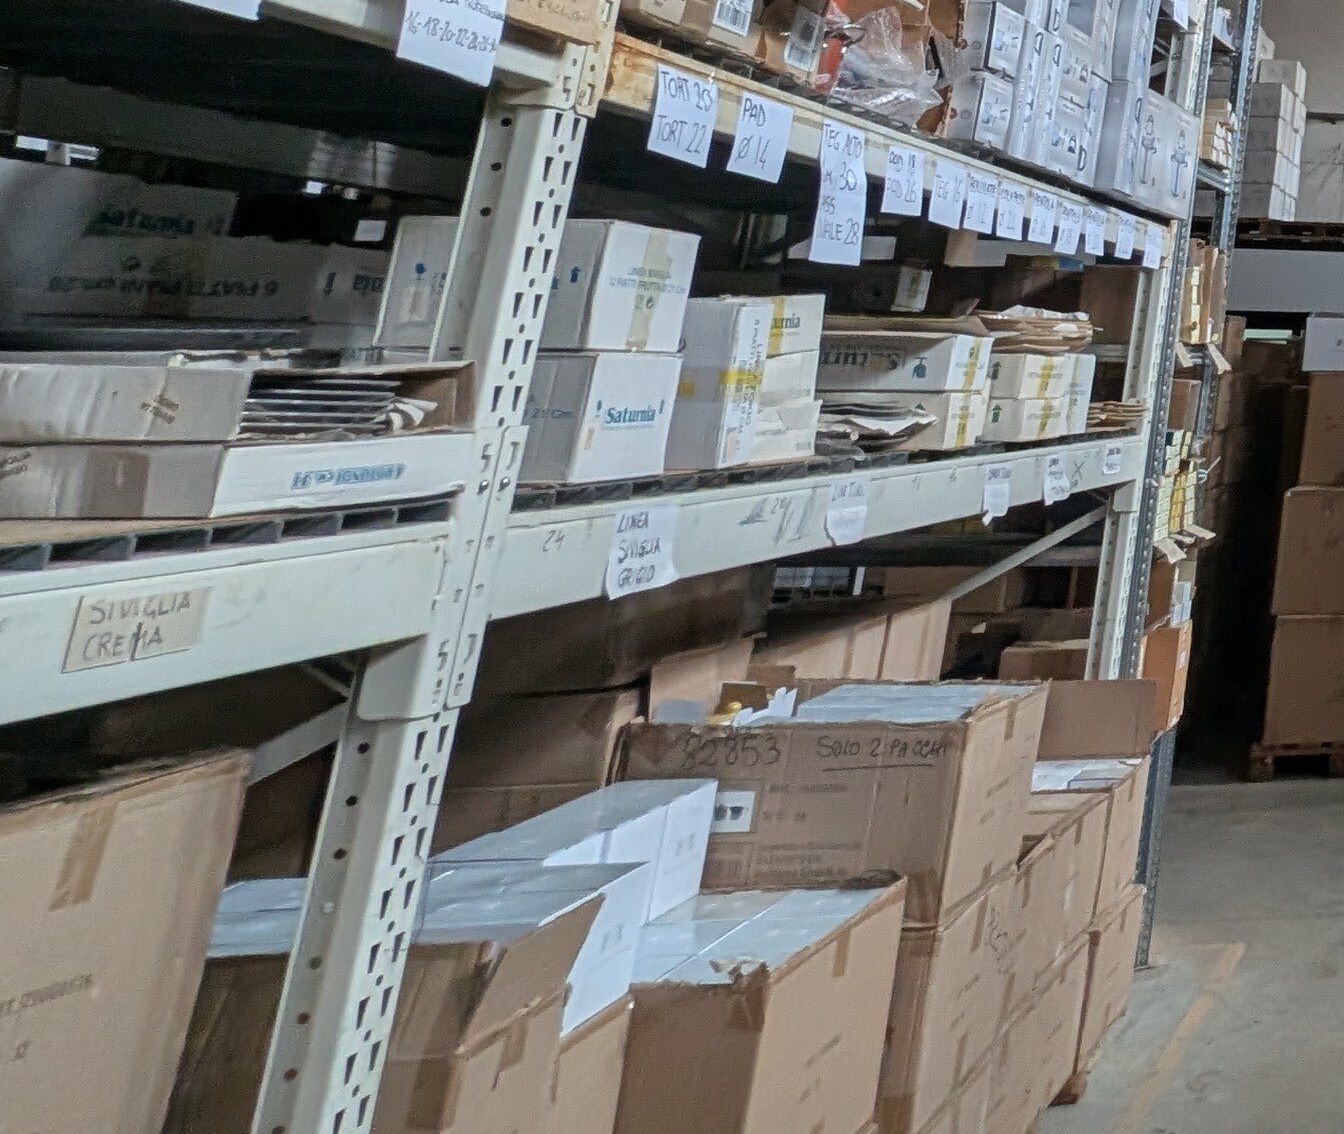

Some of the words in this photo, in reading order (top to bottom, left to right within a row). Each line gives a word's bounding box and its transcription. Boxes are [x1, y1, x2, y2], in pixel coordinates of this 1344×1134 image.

[660, 70, 691, 102] TORT
[743, 97, 766, 127] PAD
[656, 115, 688, 148] TORT
[686, 121, 707, 155] 22
[824, 123, 840, 151] TEG
[754, 136, 770, 171] 14
[838, 161, 858, 192] 30
[843, 217, 859, 247] 28
[605, 406, 656, 424] Saturnia
[617, 510, 650, 534] LINEA
[89, 593, 191, 625] SIVIGLIA
